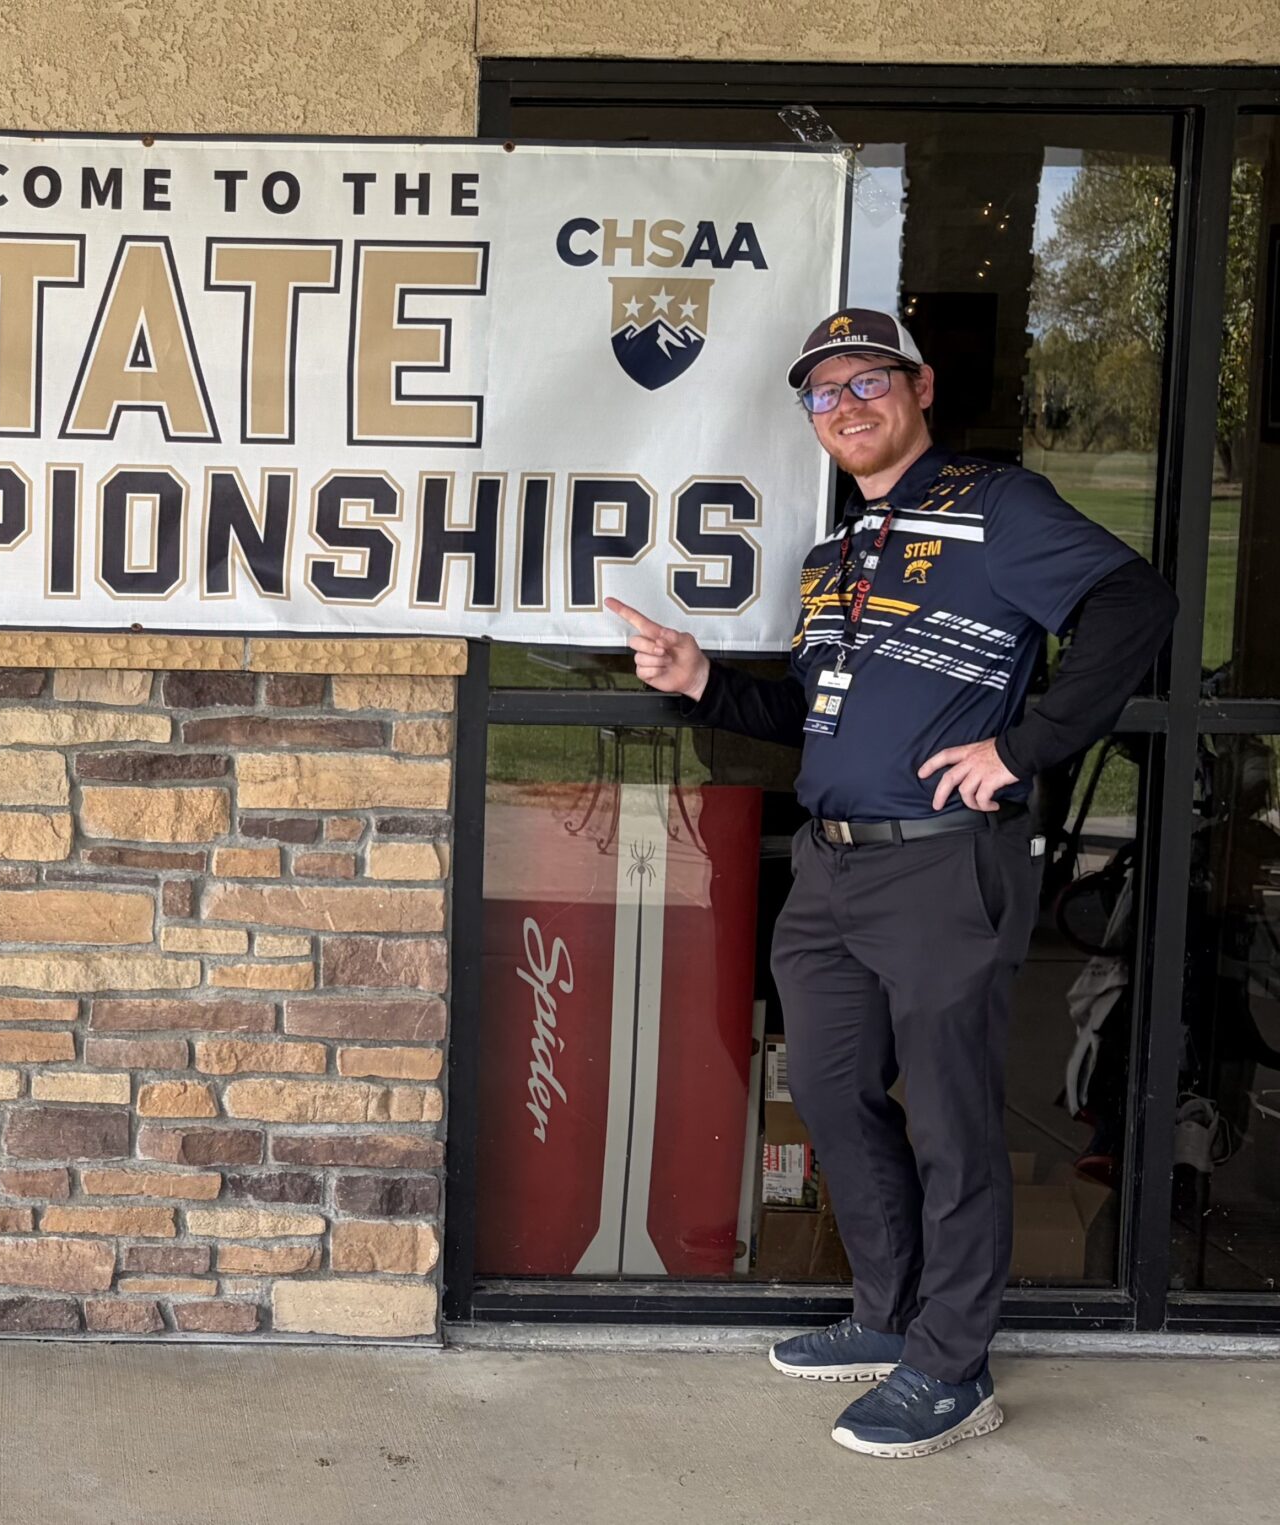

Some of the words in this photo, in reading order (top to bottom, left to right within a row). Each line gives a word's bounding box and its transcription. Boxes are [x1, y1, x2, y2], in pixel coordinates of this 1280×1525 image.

[214, 170, 300, 215] TO
[343, 173, 479, 216] THE
[556, 217, 769, 270] CHSAA
[904, 540, 942, 559] STEM
[850, 593, 865, 623] CIRCLE
[516, 916, 574, 1144] Spider
